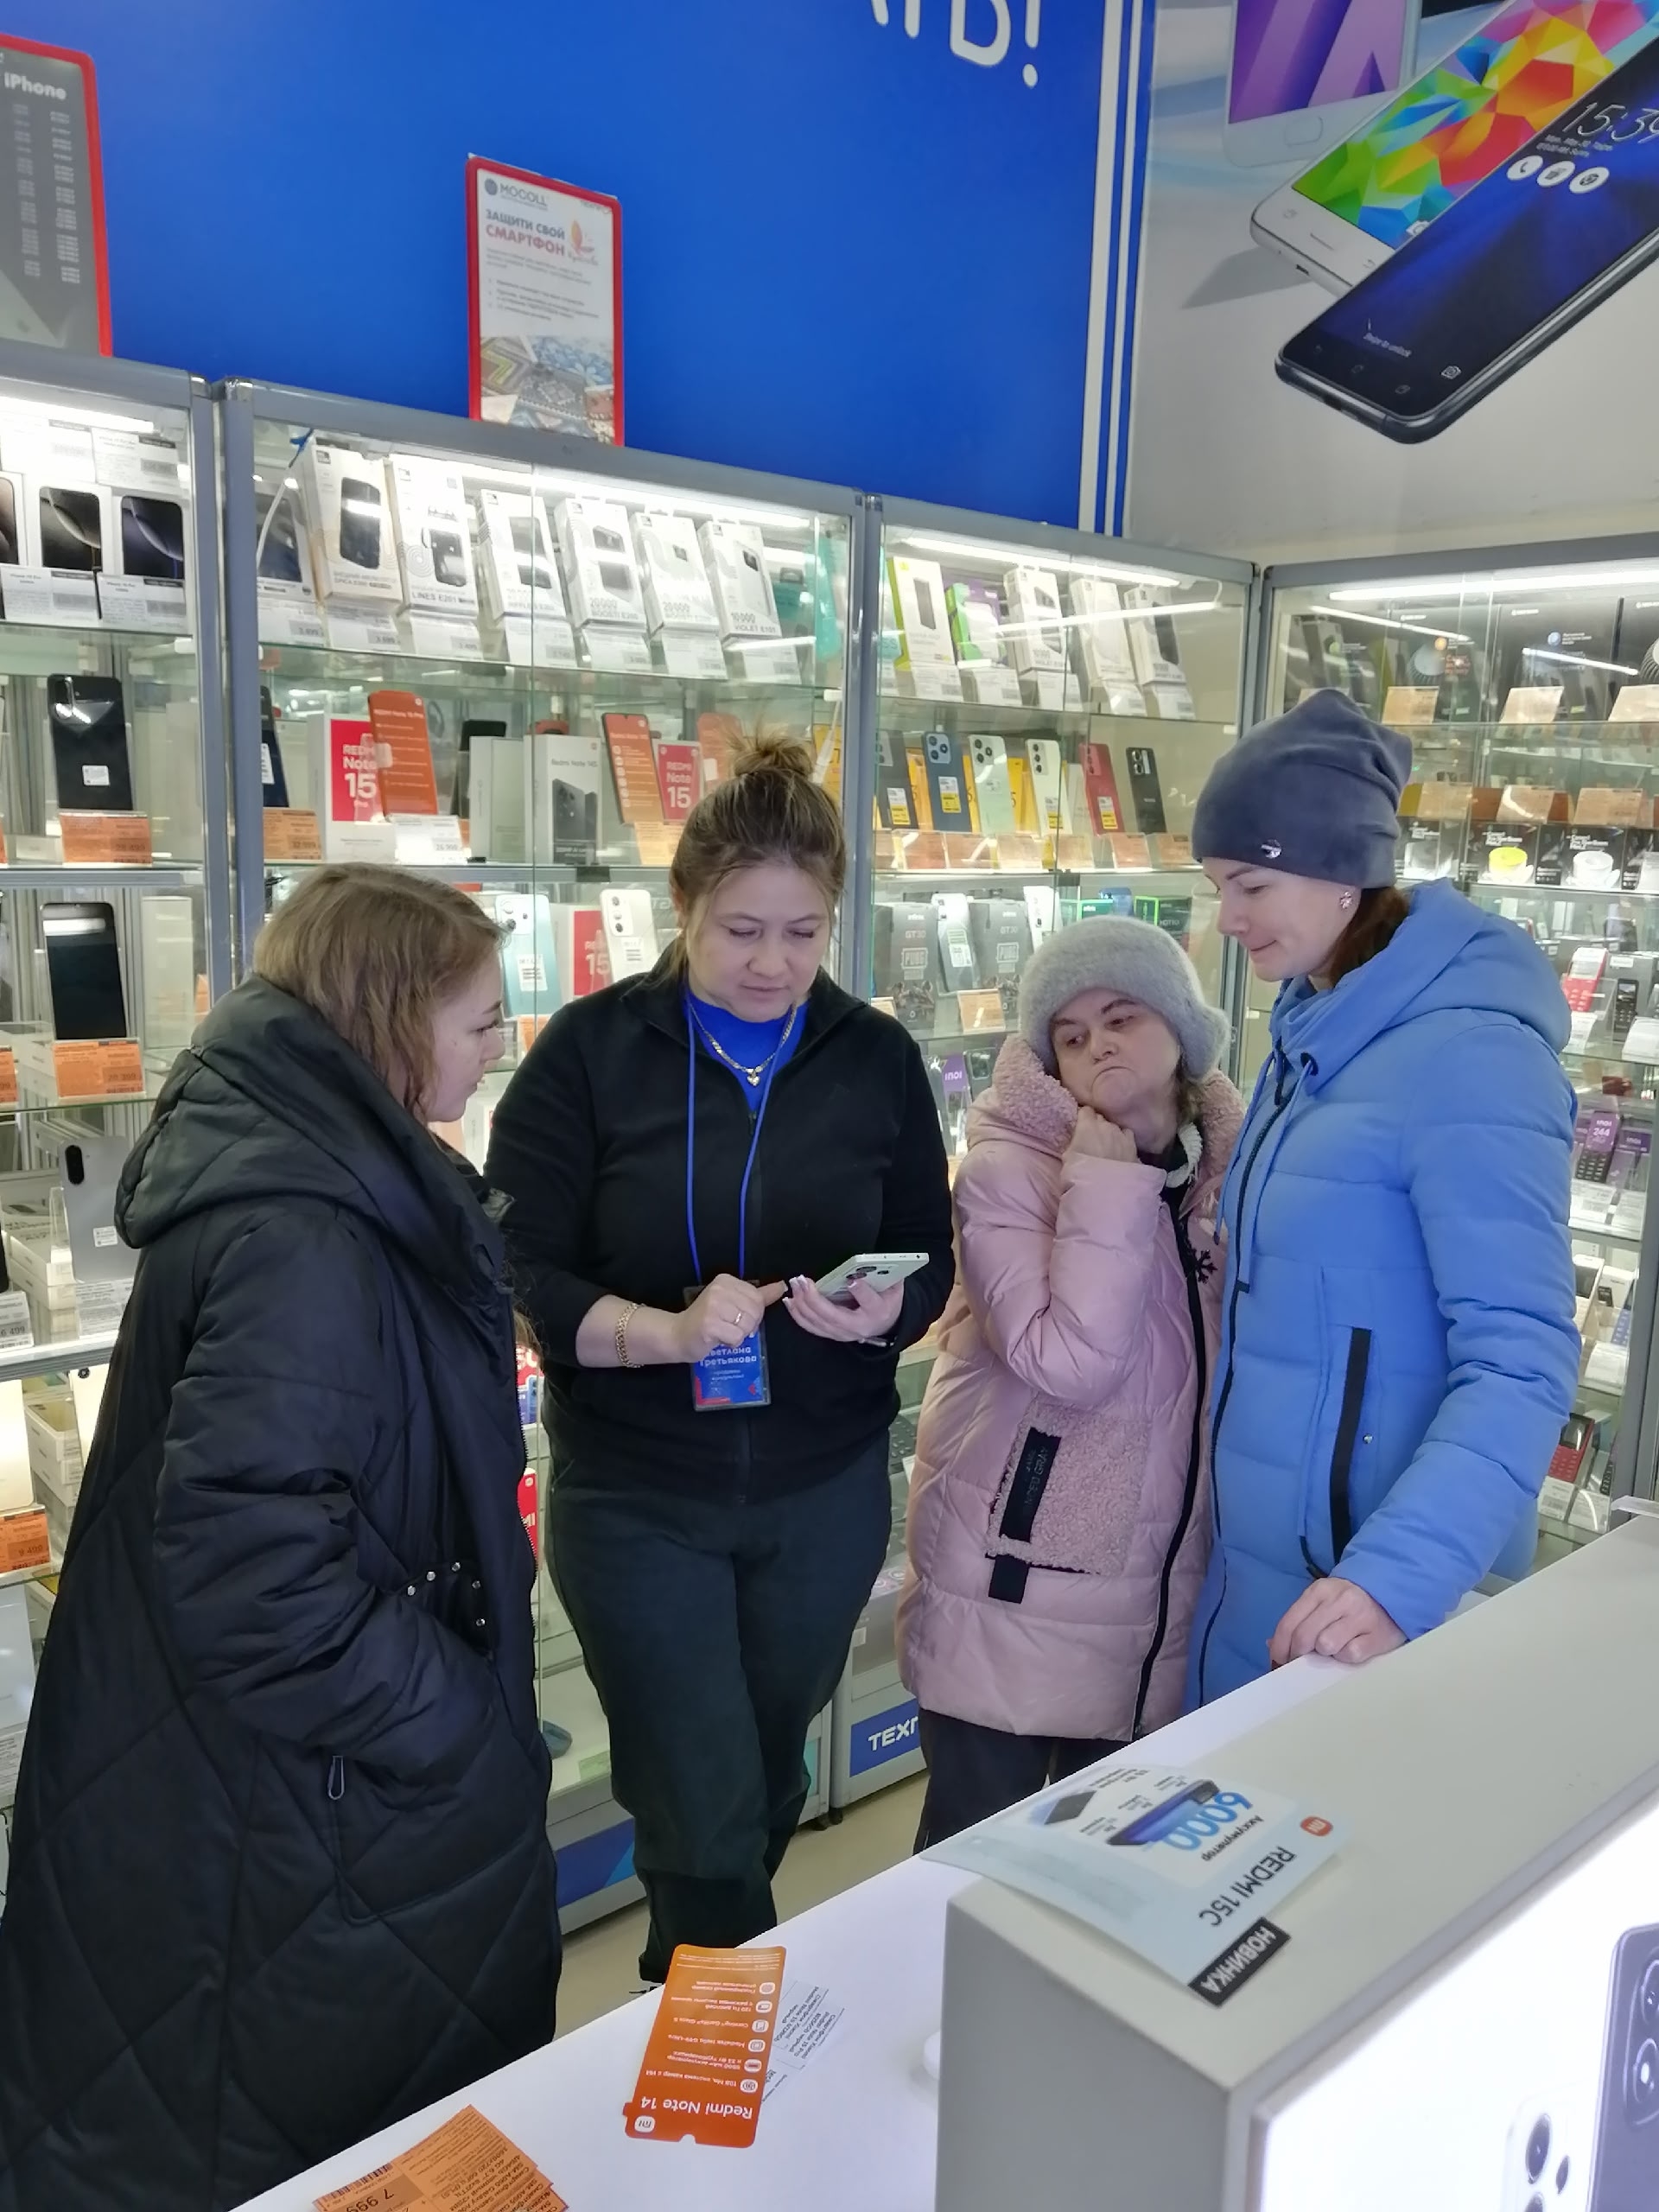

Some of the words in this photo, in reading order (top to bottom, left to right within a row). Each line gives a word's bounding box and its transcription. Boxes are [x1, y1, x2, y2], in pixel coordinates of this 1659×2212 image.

[4, 72, 67, 100] iPhone
[486, 208, 533, 231] ЗАЩИТИ
[536, 223, 565, 239] СВОЙ
[486, 225, 565, 257] СМАРТФОН
[343, 744, 377, 755] REDM
[343, 757, 377, 770] Note
[345, 773, 378, 799] 15
[666, 772, 692, 784] Note
[667, 786, 691, 808] 15
[586, 953, 611, 975] 15
[1592, 1127, 1611, 1136] 244
[710, 1346, 752, 1357] ветлана
[1166, 1790, 1254, 1851] 6000
[1201, 1814, 1265, 1862] Аккумулятор
[1230, 1846, 1297, 1899] REDMI
[1198, 1894, 1242, 1928] 15C
[1200, 1926, 1277, 1993] НОВИНКА
[641, 2095, 657, 2109] 14
[664, 2099, 701, 2114] Note
[705, 2104, 753, 2120] Redmi
[384, 2189, 395, 2200] 7
